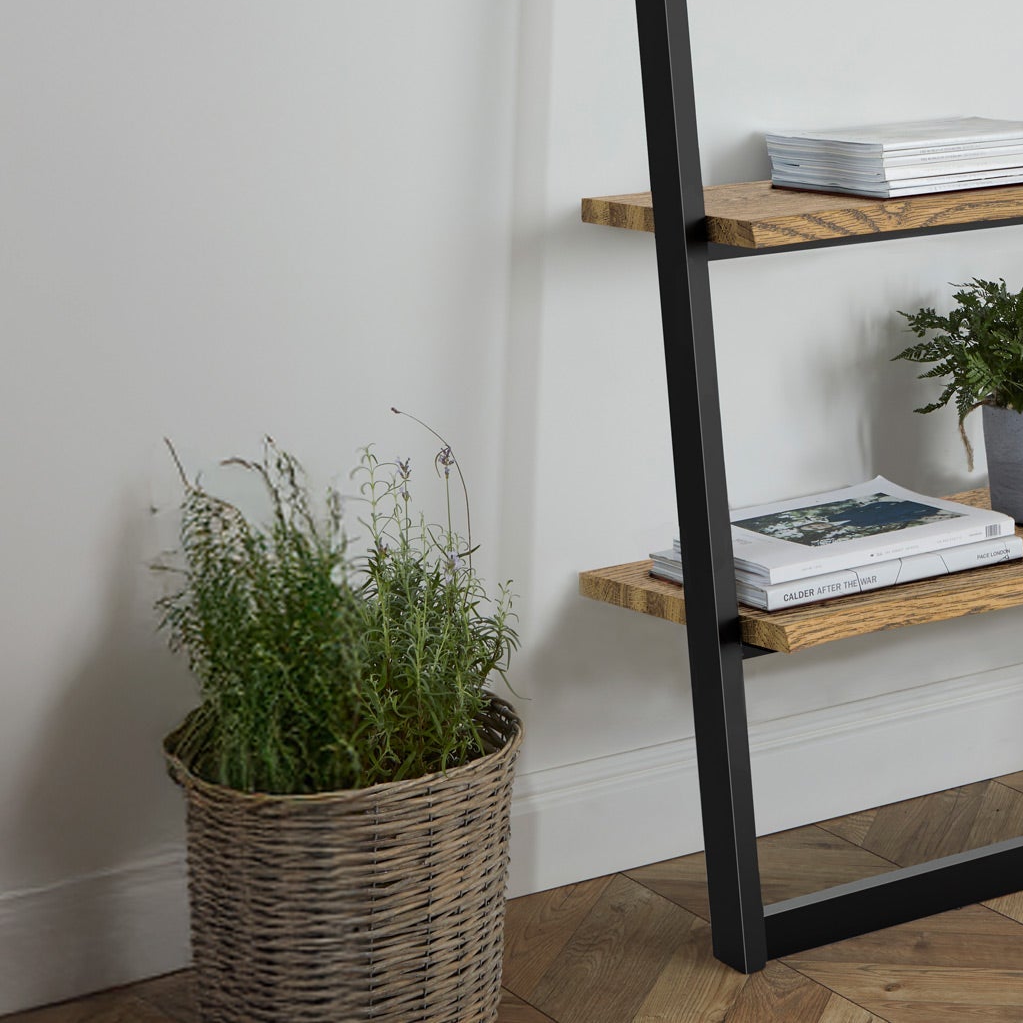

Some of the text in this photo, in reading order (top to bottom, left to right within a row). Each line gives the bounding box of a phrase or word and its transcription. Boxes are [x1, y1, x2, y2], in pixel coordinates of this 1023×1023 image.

[990, 548, 1011, 557] LONDON
[783, 575, 878, 602] CALDER AFTER THE WAR
